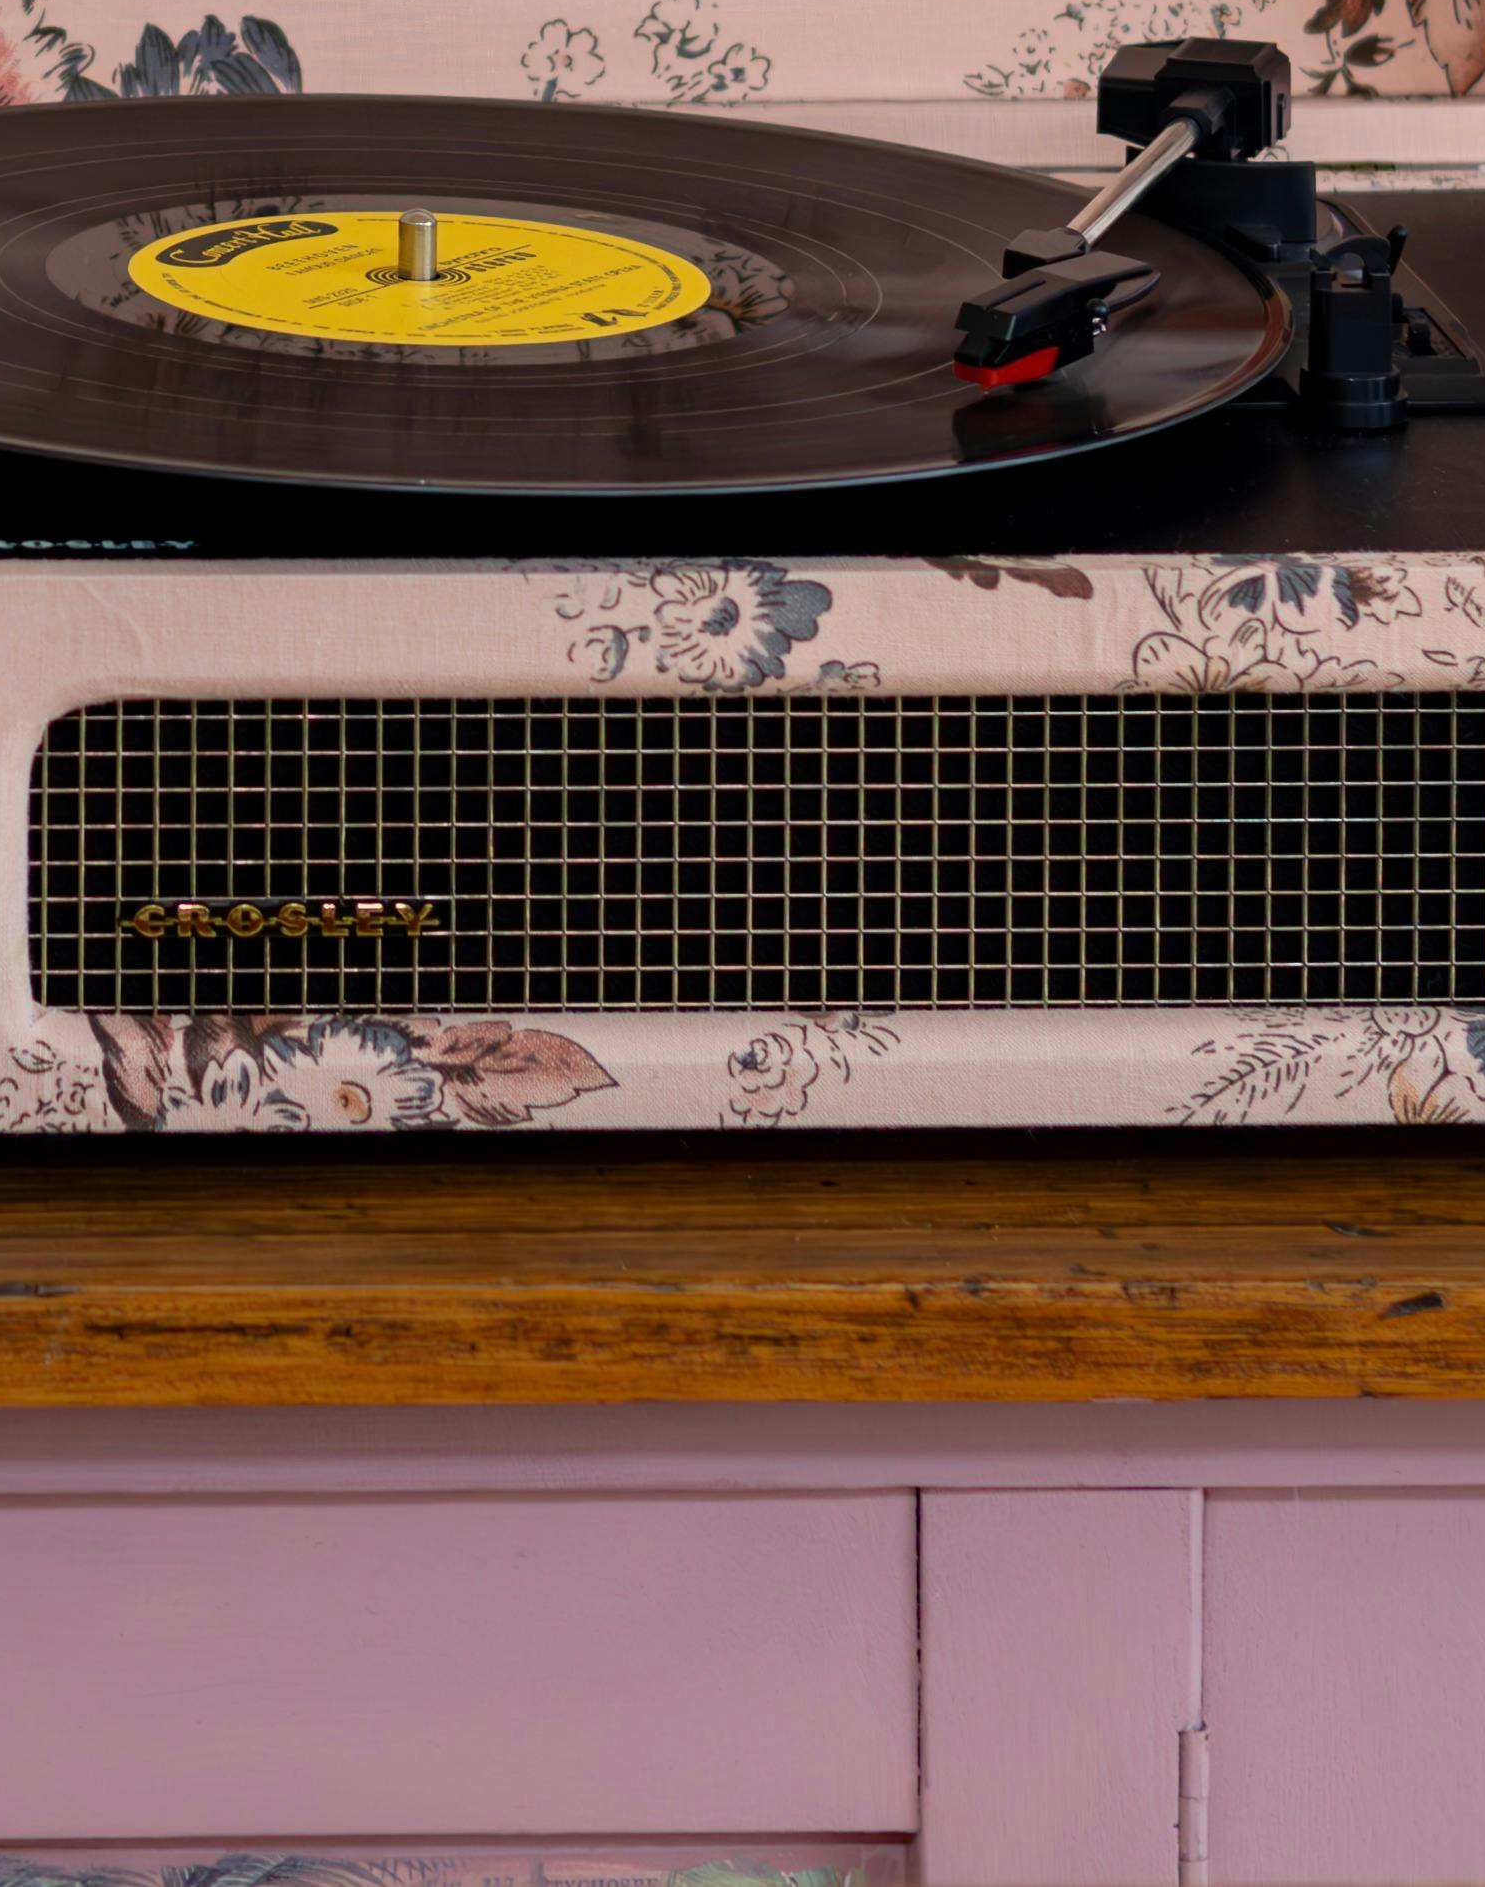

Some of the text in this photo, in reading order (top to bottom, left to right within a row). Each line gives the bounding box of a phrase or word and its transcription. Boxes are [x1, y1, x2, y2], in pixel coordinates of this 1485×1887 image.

[265, 243, 360, 271] BEETHOVEN
[465, 251, 537, 272] stereo
[129, 901, 436, 938] CROSLEY
